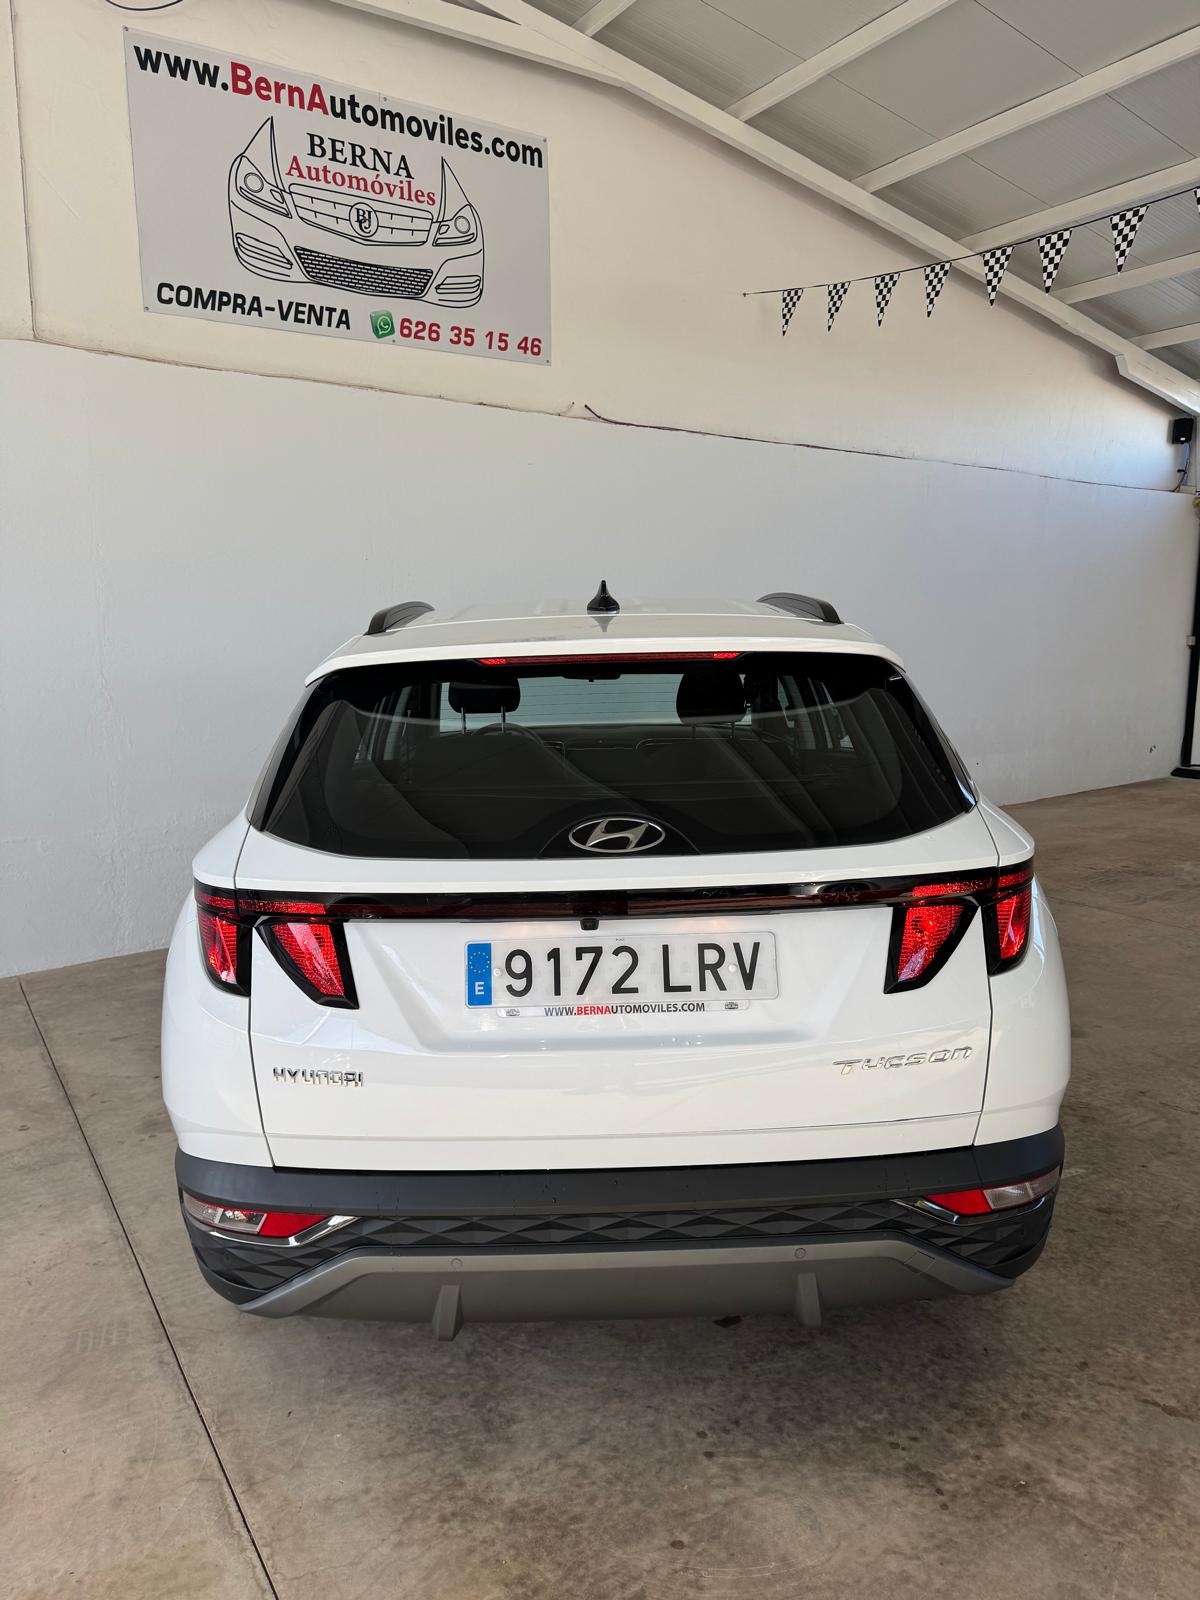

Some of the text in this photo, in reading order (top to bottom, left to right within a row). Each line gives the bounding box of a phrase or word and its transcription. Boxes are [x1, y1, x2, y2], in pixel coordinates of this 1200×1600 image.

[133, 45, 543, 168] www.BernAutomoviles.com
[306, 132, 414, 179] BERNA
[285, 155, 436, 207] Automóviles
[156, 282, 351, 330] COMPRA-VENTA
[399, 318, 542, 356] 626 35 15 46
[475, 981, 485, 995] E
[504, 941, 761, 997] 9172 LRV
[544, 1002, 705, 1016] WWW.BERNAUTOMOVILES.COM
[272, 1067, 364, 1087] HYUNDAI
